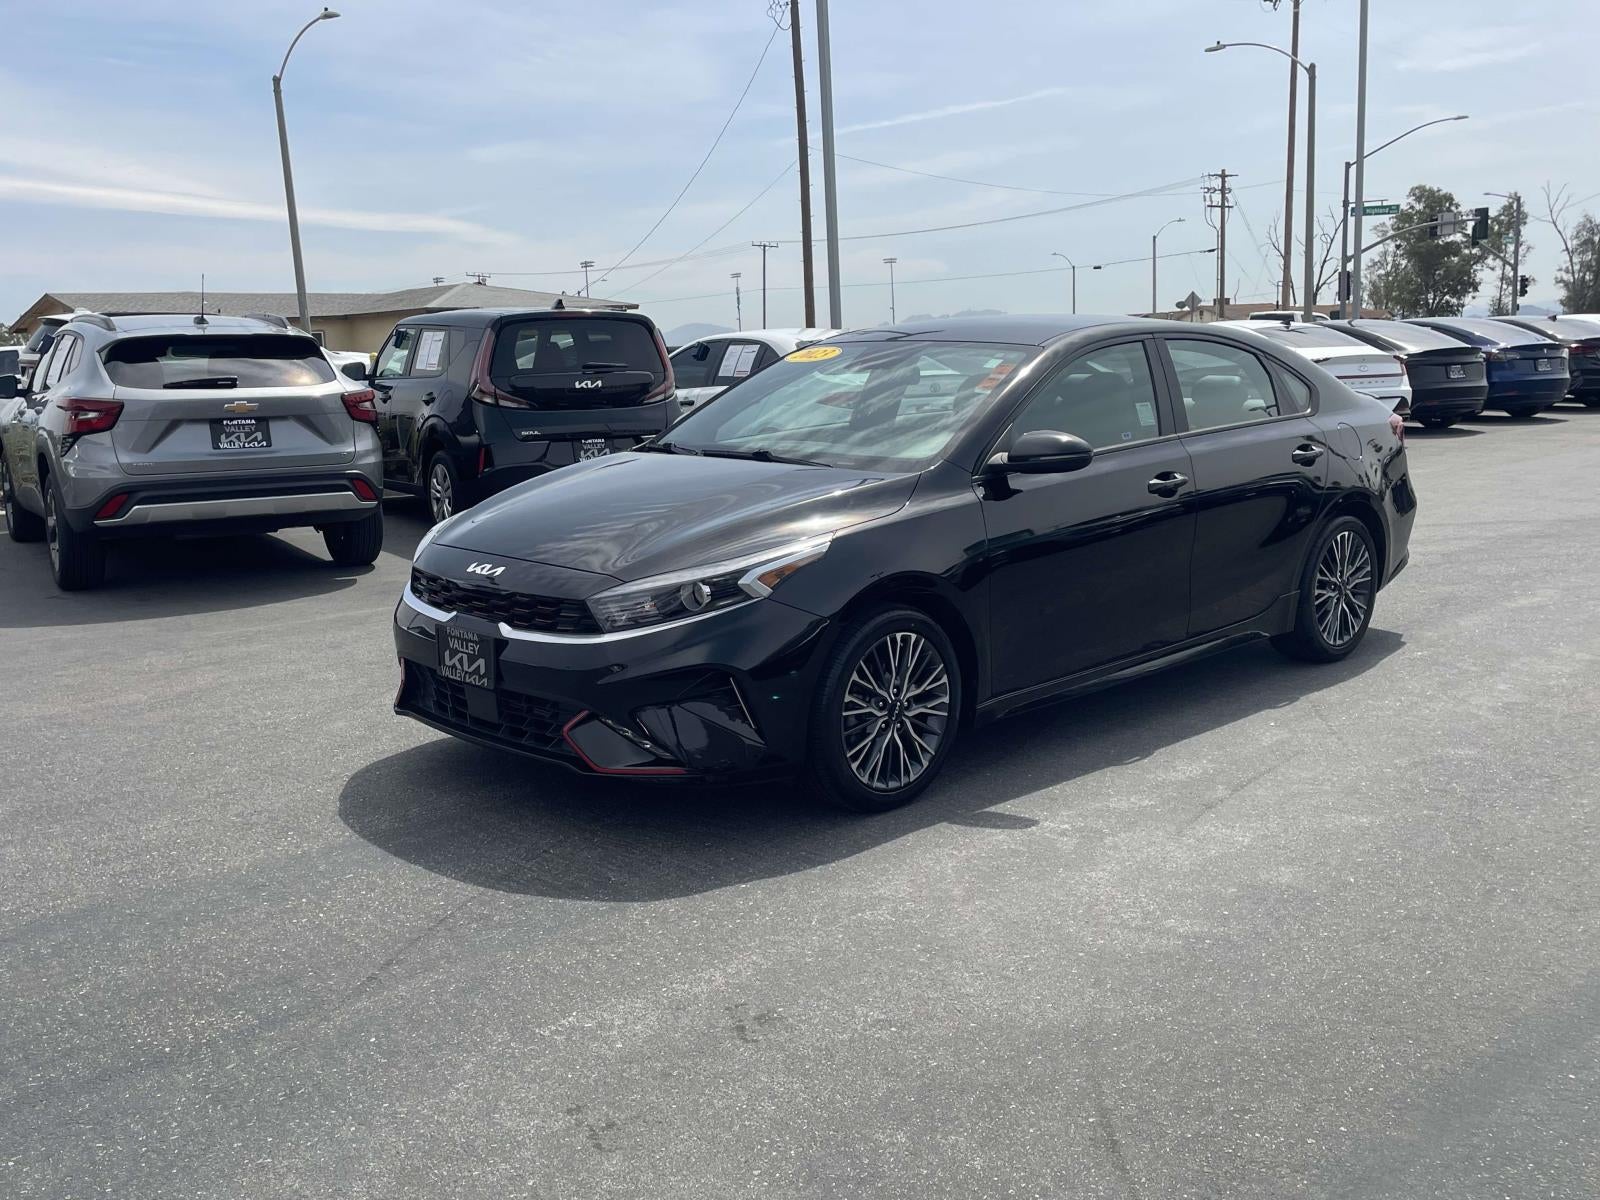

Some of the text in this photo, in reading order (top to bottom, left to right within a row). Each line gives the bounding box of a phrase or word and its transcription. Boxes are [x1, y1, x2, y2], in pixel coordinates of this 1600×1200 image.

[574, 380, 602, 389] KIA
[224, 425, 256, 433] VALLEY
[221, 432, 262, 442] KIA
[218, 441, 244, 449] VALLEY
[466, 561, 506, 577] KIA
[446, 627, 478, 641] FONTANA
[448, 636, 480, 655] VALLEY
[444, 649, 486, 676] KIA
[441, 664, 488, 687] VALLEY KIA
